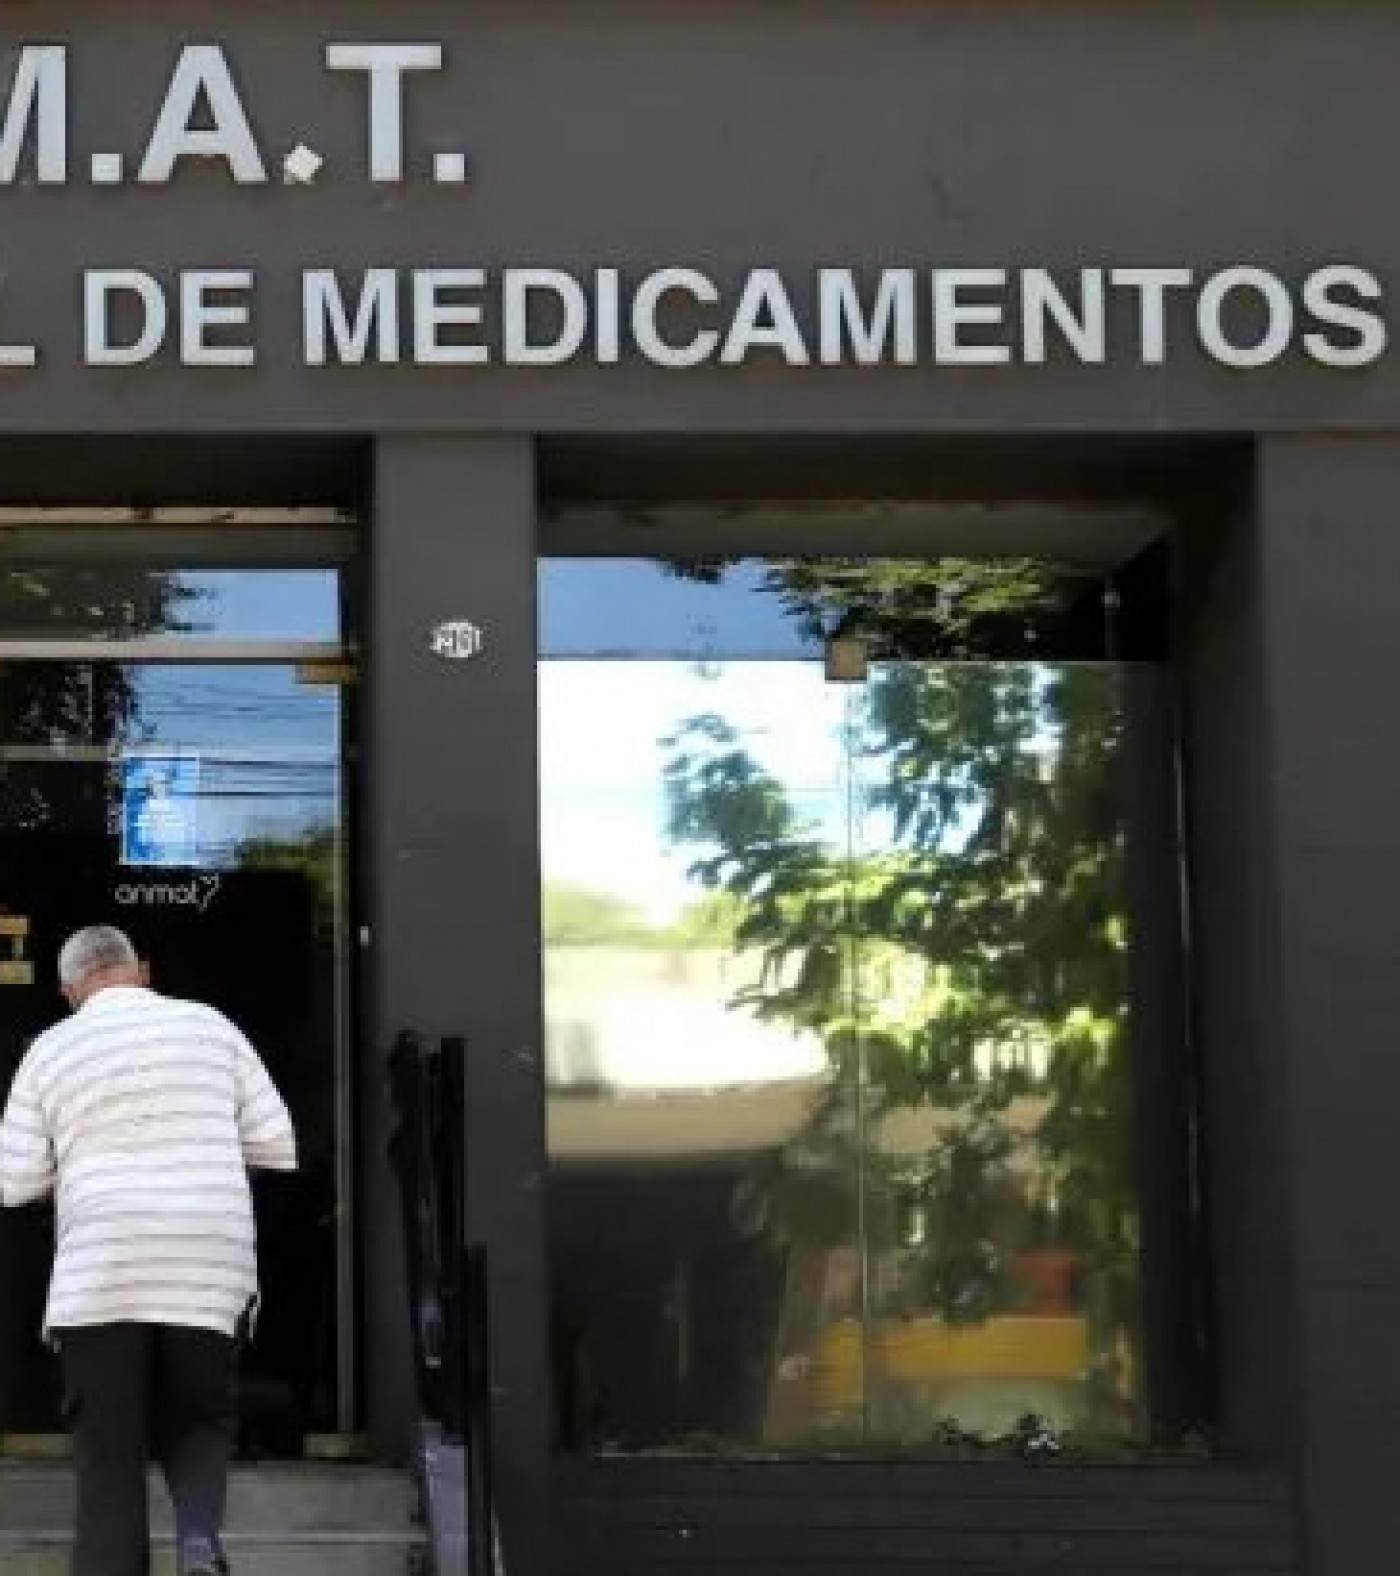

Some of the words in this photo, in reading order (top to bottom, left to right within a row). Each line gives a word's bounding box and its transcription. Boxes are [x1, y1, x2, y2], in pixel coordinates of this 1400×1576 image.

[85, 269, 253, 365] DE
[303, 265, 1385, 365] MEDICAMENTOS
[114, 880, 198, 904] anmat
